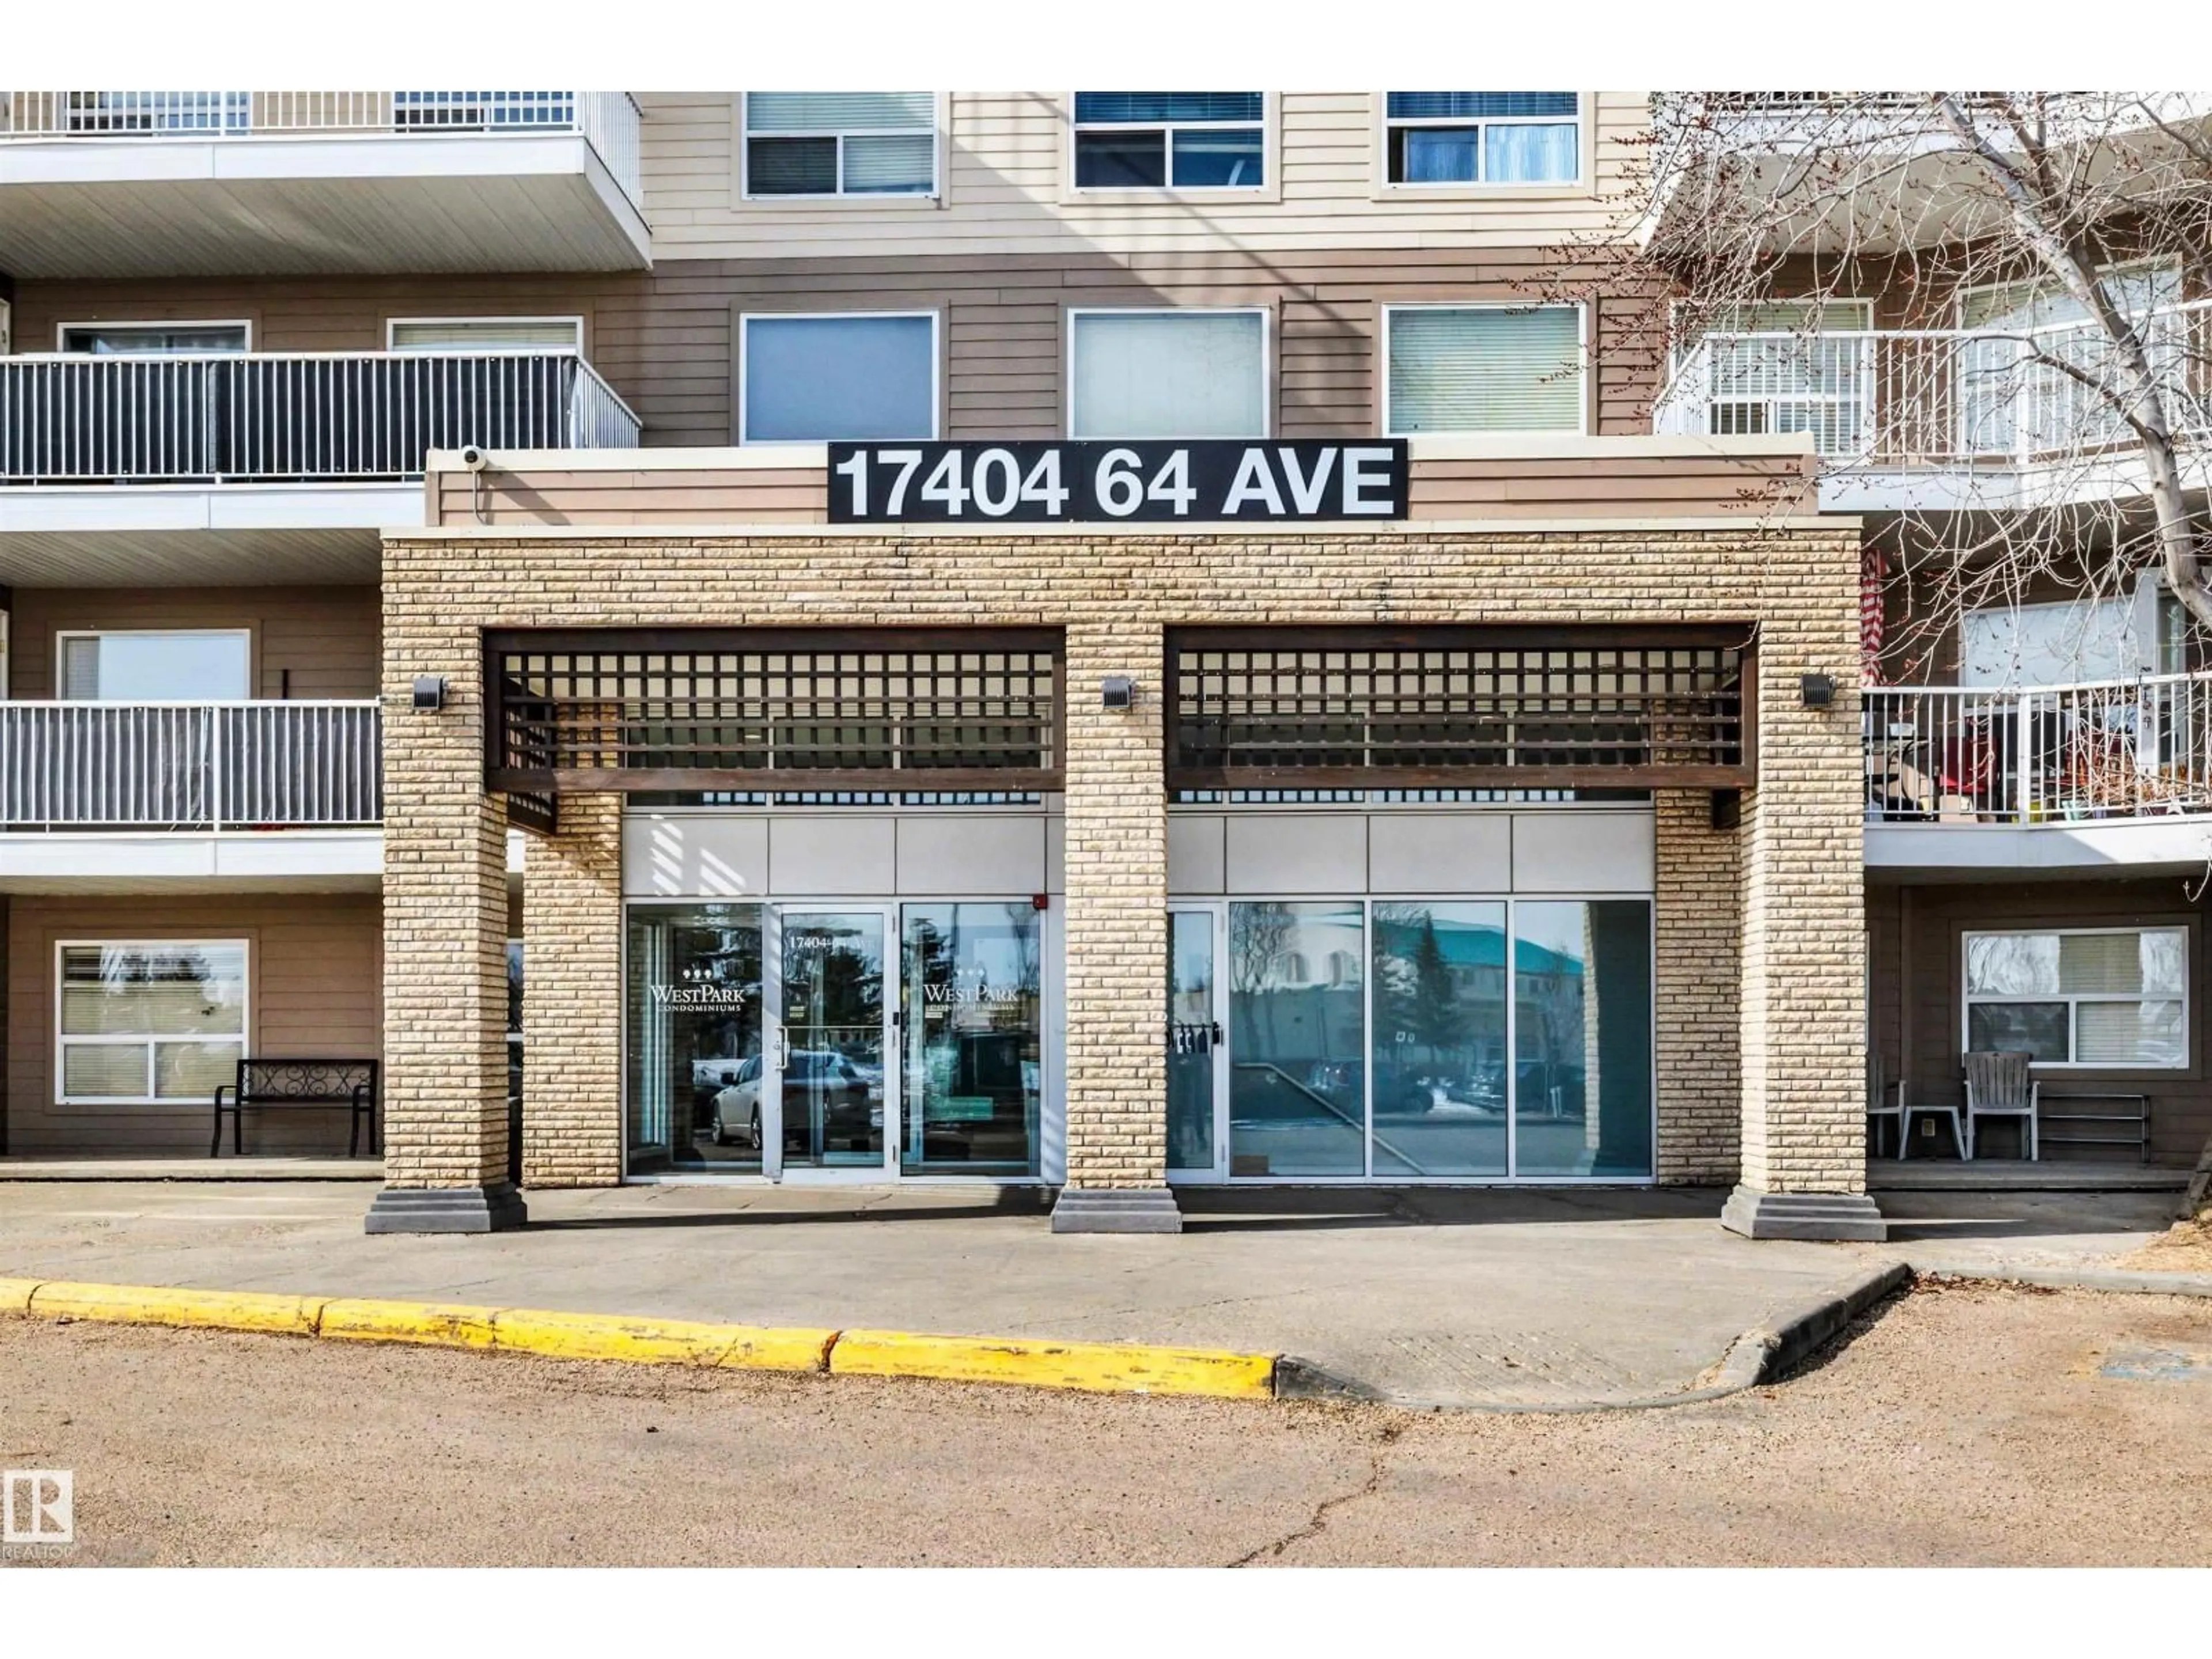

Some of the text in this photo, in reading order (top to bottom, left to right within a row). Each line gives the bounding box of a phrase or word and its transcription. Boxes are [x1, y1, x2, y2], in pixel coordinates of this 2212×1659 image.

[836, 448, 1393, 516] 17404 64 AVE
